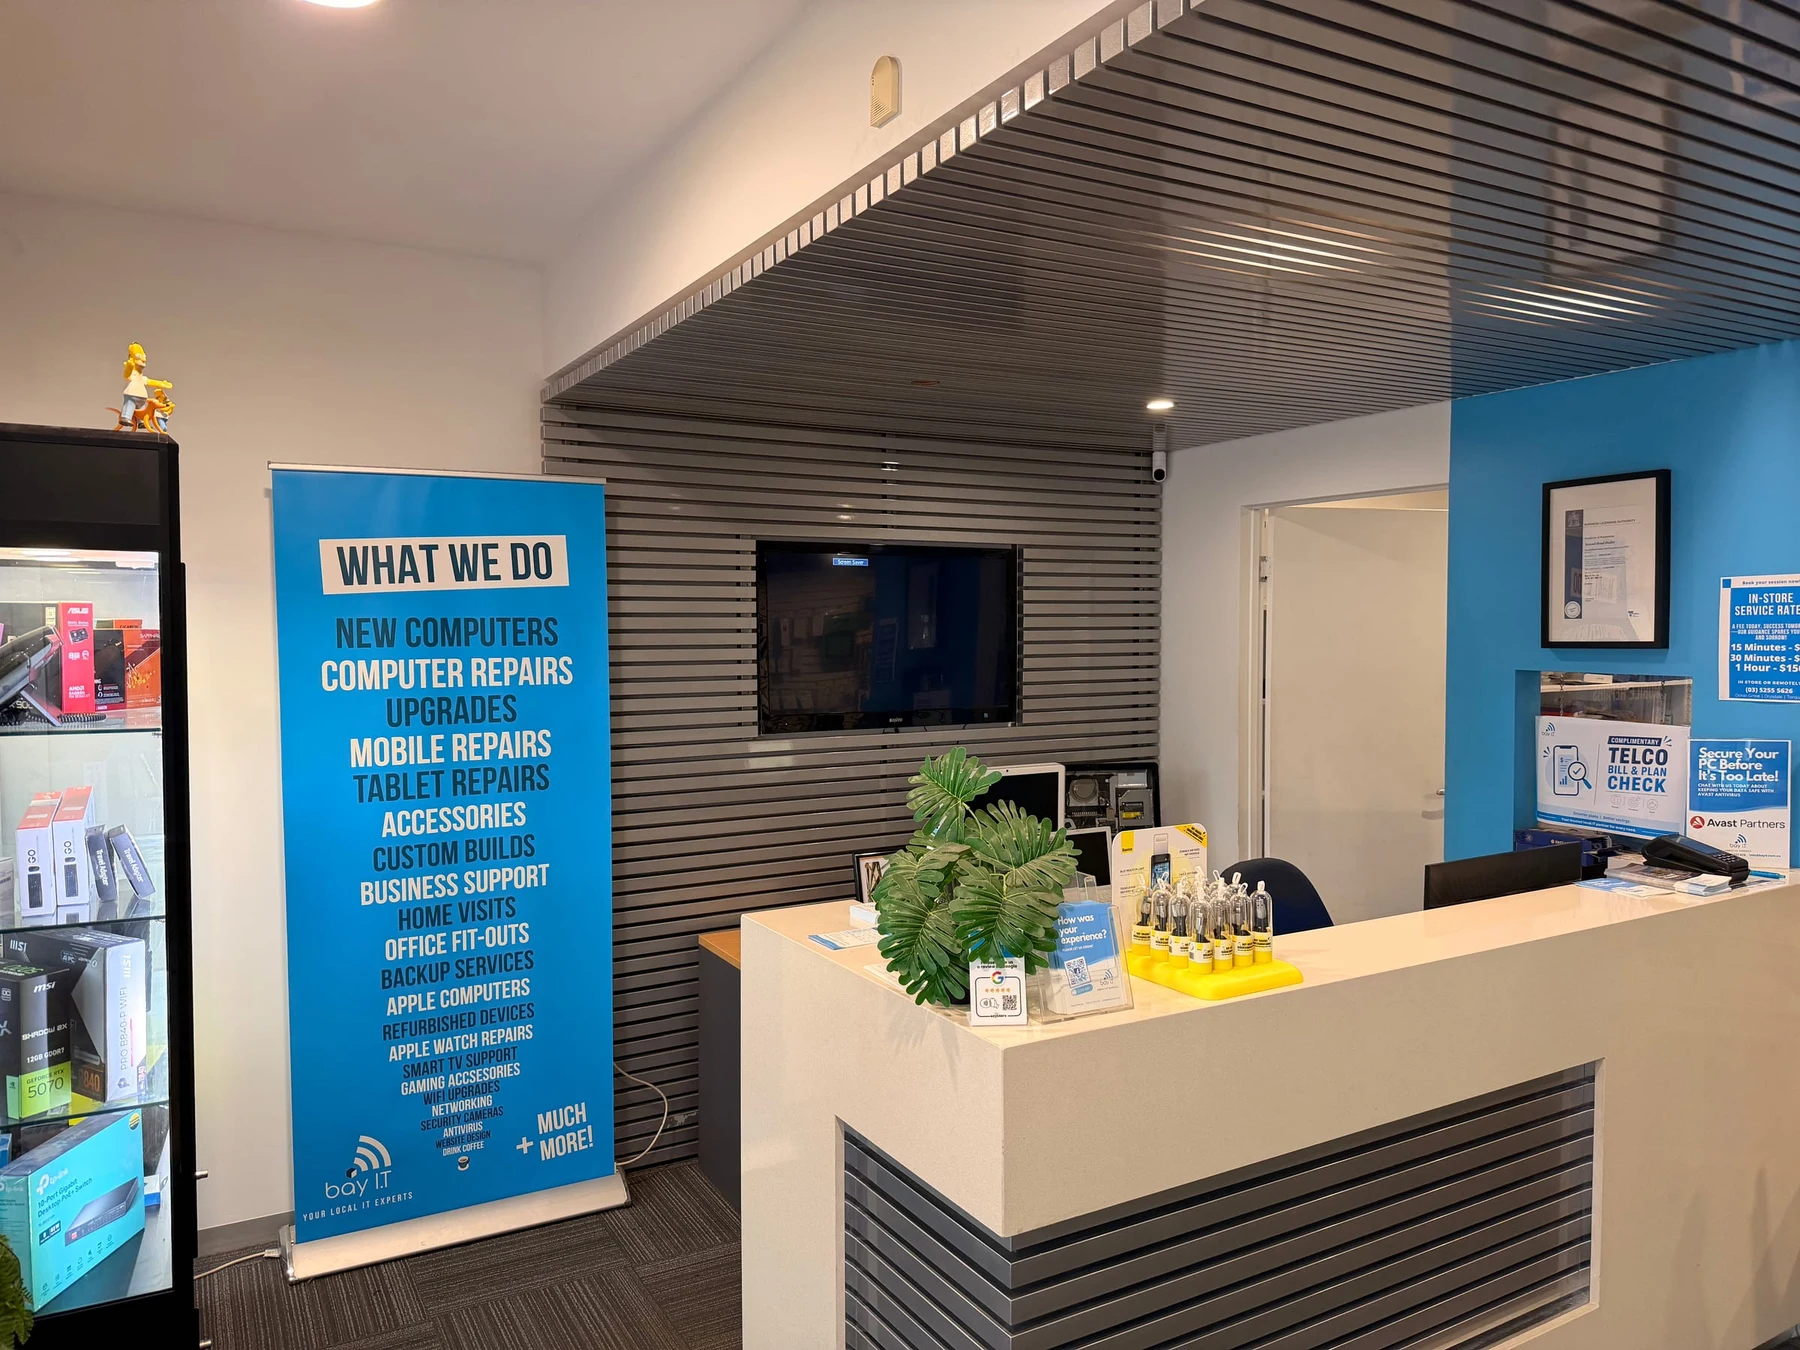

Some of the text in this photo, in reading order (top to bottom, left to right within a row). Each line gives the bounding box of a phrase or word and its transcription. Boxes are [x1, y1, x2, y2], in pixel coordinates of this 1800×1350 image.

[336, 542, 552, 586] WHAT WE DO
[1748, 593, 1794, 604] IN-STORE
[1735, 606, 1774, 616] SERVICE
[336, 617, 558, 649] NEW COMPUTERS
[1730, 654, 1786, 662] 30 Minutes
[1744, 643, 1786, 651] Minutes
[321, 656, 573, 692] COMPUTER REPAIRS
[1743, 664, 1771, 672] Hour
[1779, 664, 1800, 672] $15
[386, 694, 517, 727] UPGRADES
[350, 730, 551, 768] MOBILE REPAIRS
[1610, 737, 1659, 745] COMPLIMENTARY
[1608, 747, 1668, 765] TELCO
[1699, 747, 1779, 759] Secure Your
[1608, 765, 1667, 776] BILL & PLAN
[1699, 759, 1763, 770] PC Before
[353, 764, 550, 803] TABLET REPAIRS
[1607, 776, 1666, 793] CHECK
[1699, 770, 1778, 782] It's Too Late!
[382, 802, 526, 838] ACCESSORIES
[1707, 819, 1785, 829] Avast Partners
[373, 834, 535, 872] CUSTOM BUILDS
[96, 849, 109, 886] Travel Adapter
[124, 848, 144, 882] Travel Adapter
[361, 864, 549, 906] BUSINESS SUPPORT
[398, 896, 516, 931] HOME VISITS
[1058, 914, 1094, 925] How was
[385, 922, 530, 961] OFFICE FIT-OUTS
[1060, 927, 1078, 937] your
[1061, 929, 1107, 946] experience?
[381, 950, 534, 989] BACKUP SERVICES
[34, 981, 56, 993] msi
[386, 978, 531, 1016] APPLE COMPUTERS
[22, 1026, 55, 1040] SHADOW
[382, 1003, 535, 1041] REFURBISHED DEVICES
[389, 1024, 533, 1062] APPLE WATCH REPAIRS
[27, 1047, 65, 1063] 12GB GDDR7
[403, 1046, 517, 1079] SMART TV SUPPORT
[27, 1072, 52, 1084] GEFORCE
[28, 1077, 64, 1099] 5070
[401, 1063, 521, 1096] GAMING ACCSESORIES
[423, 1080, 500, 1106] WIFI UPGRADES
[431, 1095, 493, 1117] NETWORKING
[420, 1106, 504, 1132] SECURITY CAMERAS
[537, 1102, 587, 1135] MUCH
[435, 1130, 491, 1149] WEBSITE DESIGN
[443, 1121, 483, 1139] ANTIVIRUS
[442, 1141, 485, 1157] DRINK COFFEE
[516, 1137, 533, 1154] +
[539, 1125, 594, 1161] MORE!
[38, 1191, 58, 1208] 10-Port
[59, 1178, 78, 1194] Gigabit
[38, 1200, 60, 1218] Desktop
[61, 1191, 74, 1203] PoE+
[75, 1178, 92, 1193] Switch
[325, 1179, 369, 1199] bay
[303, 1191, 413, 1222] YOUR LOCAL IT EXPERTS
